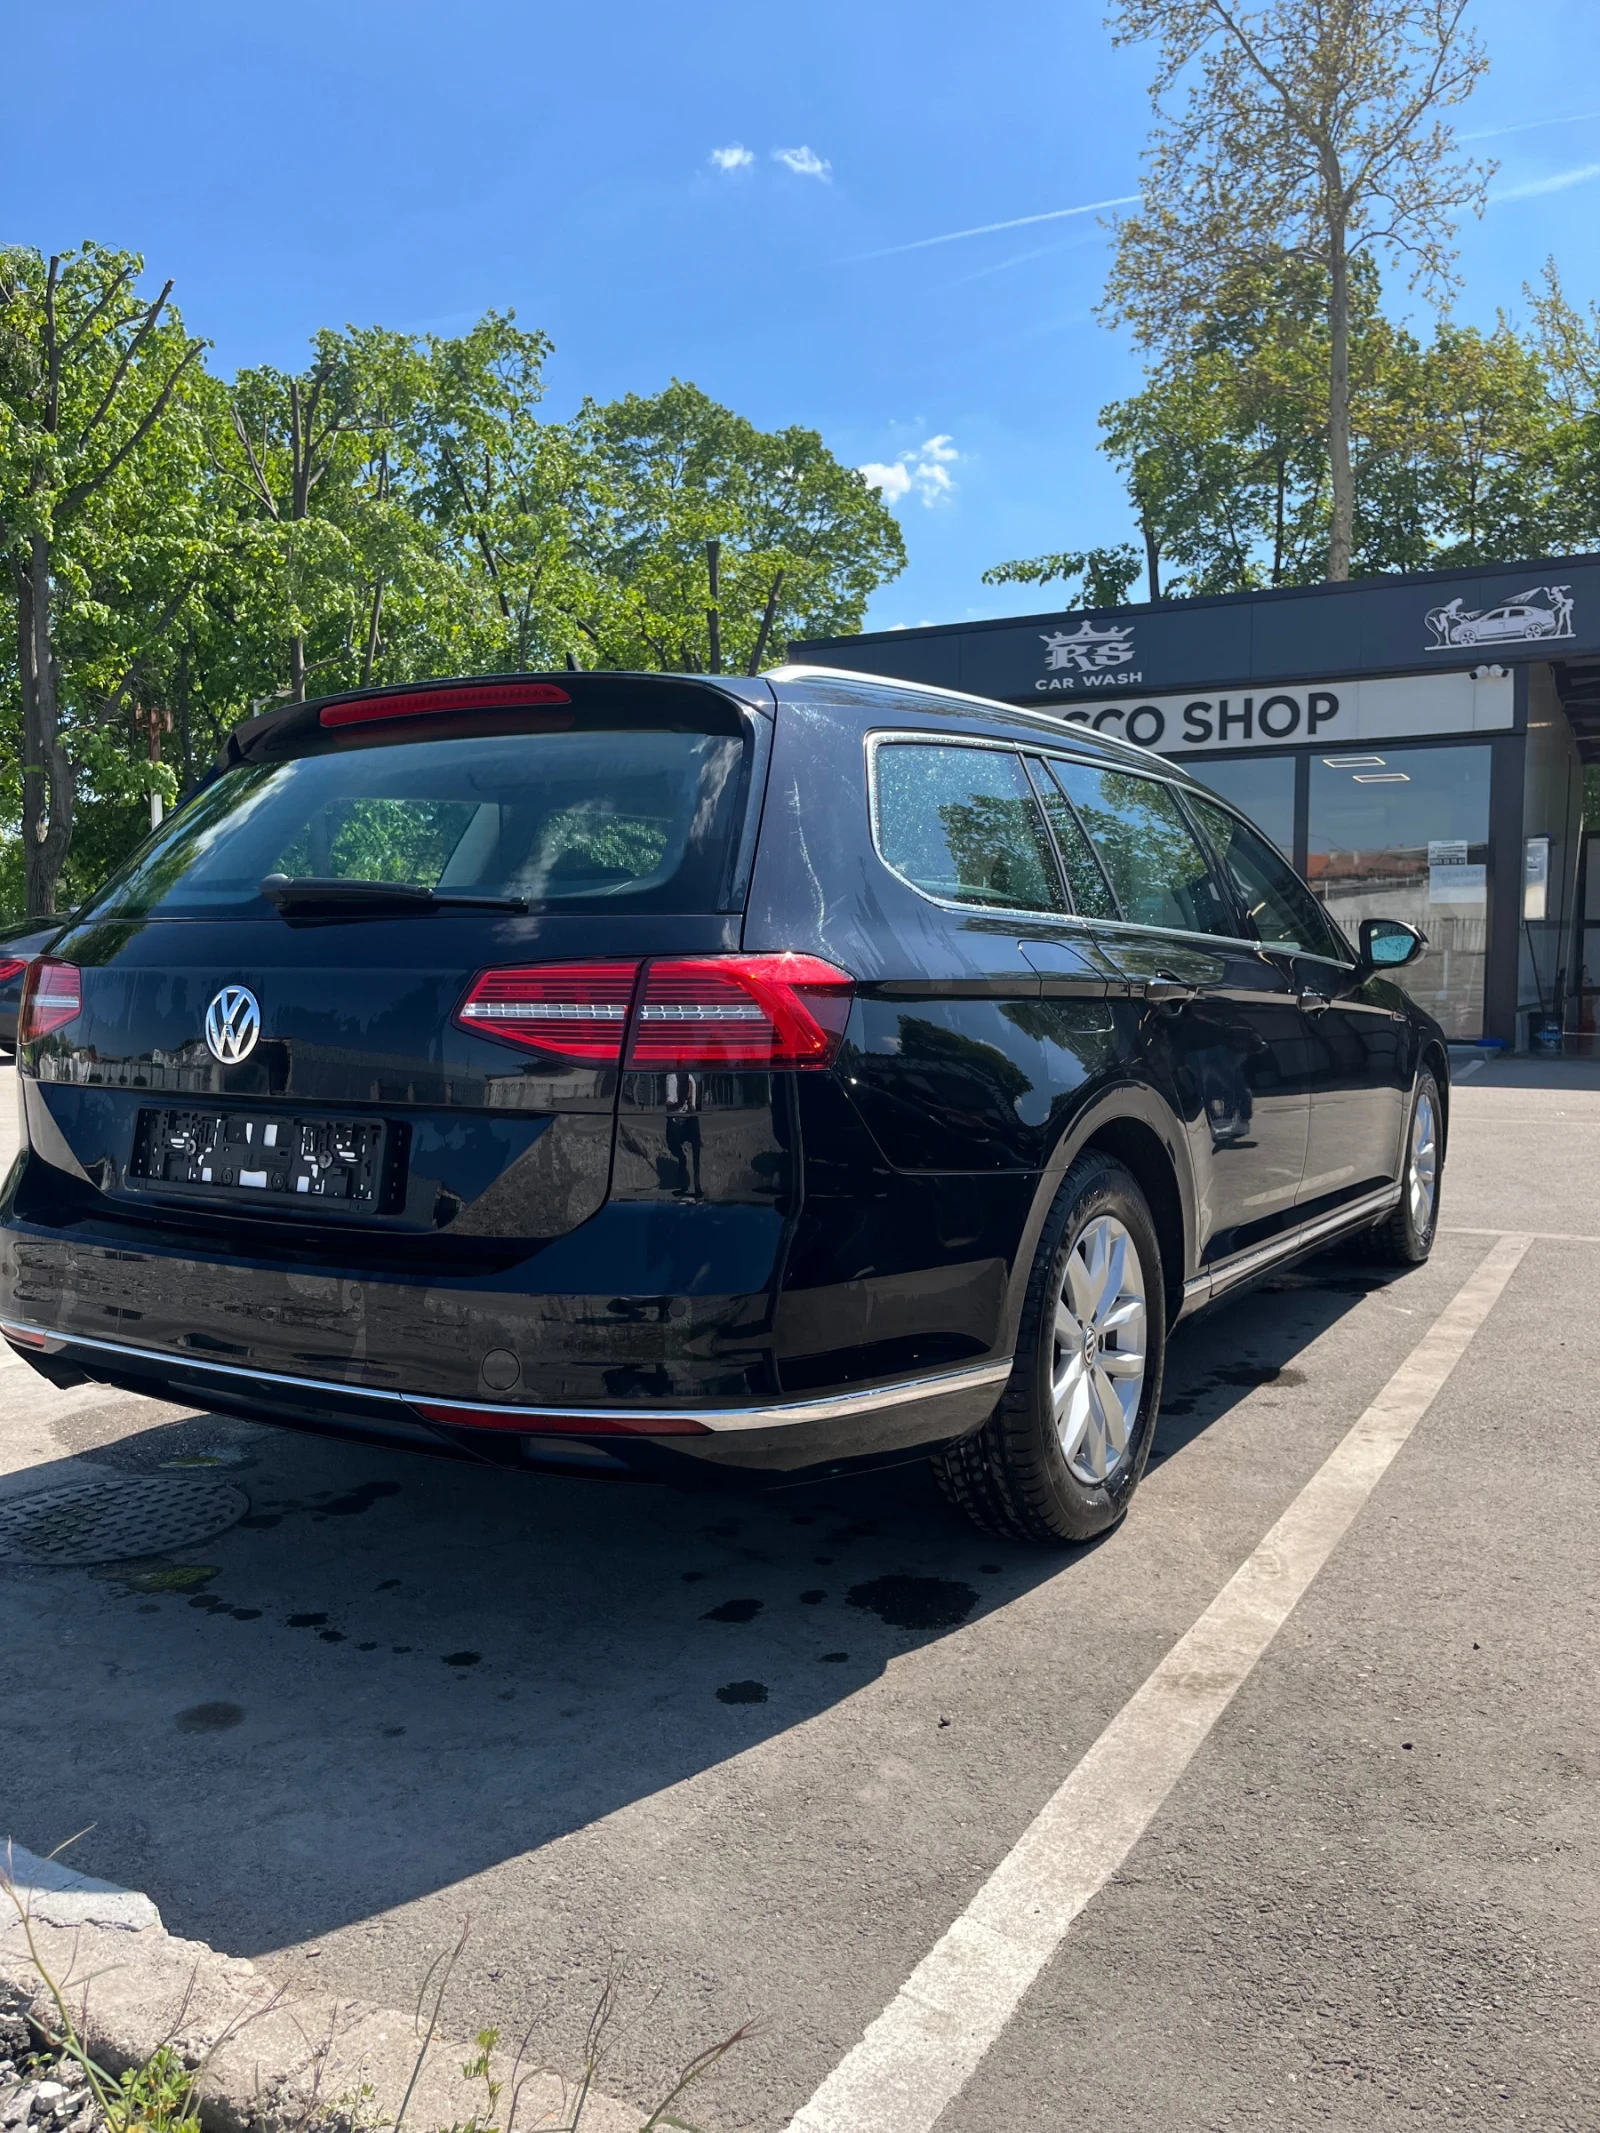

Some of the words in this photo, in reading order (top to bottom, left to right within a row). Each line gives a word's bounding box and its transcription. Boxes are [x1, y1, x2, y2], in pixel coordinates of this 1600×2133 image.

[1045, 642, 1136, 672] RS
[1035, 678, 1074, 690] CAR
[1082, 672, 1142, 687] WASH
[1182, 692, 1339, 743] SHOP
[205, 985, 260, 1065] VW
